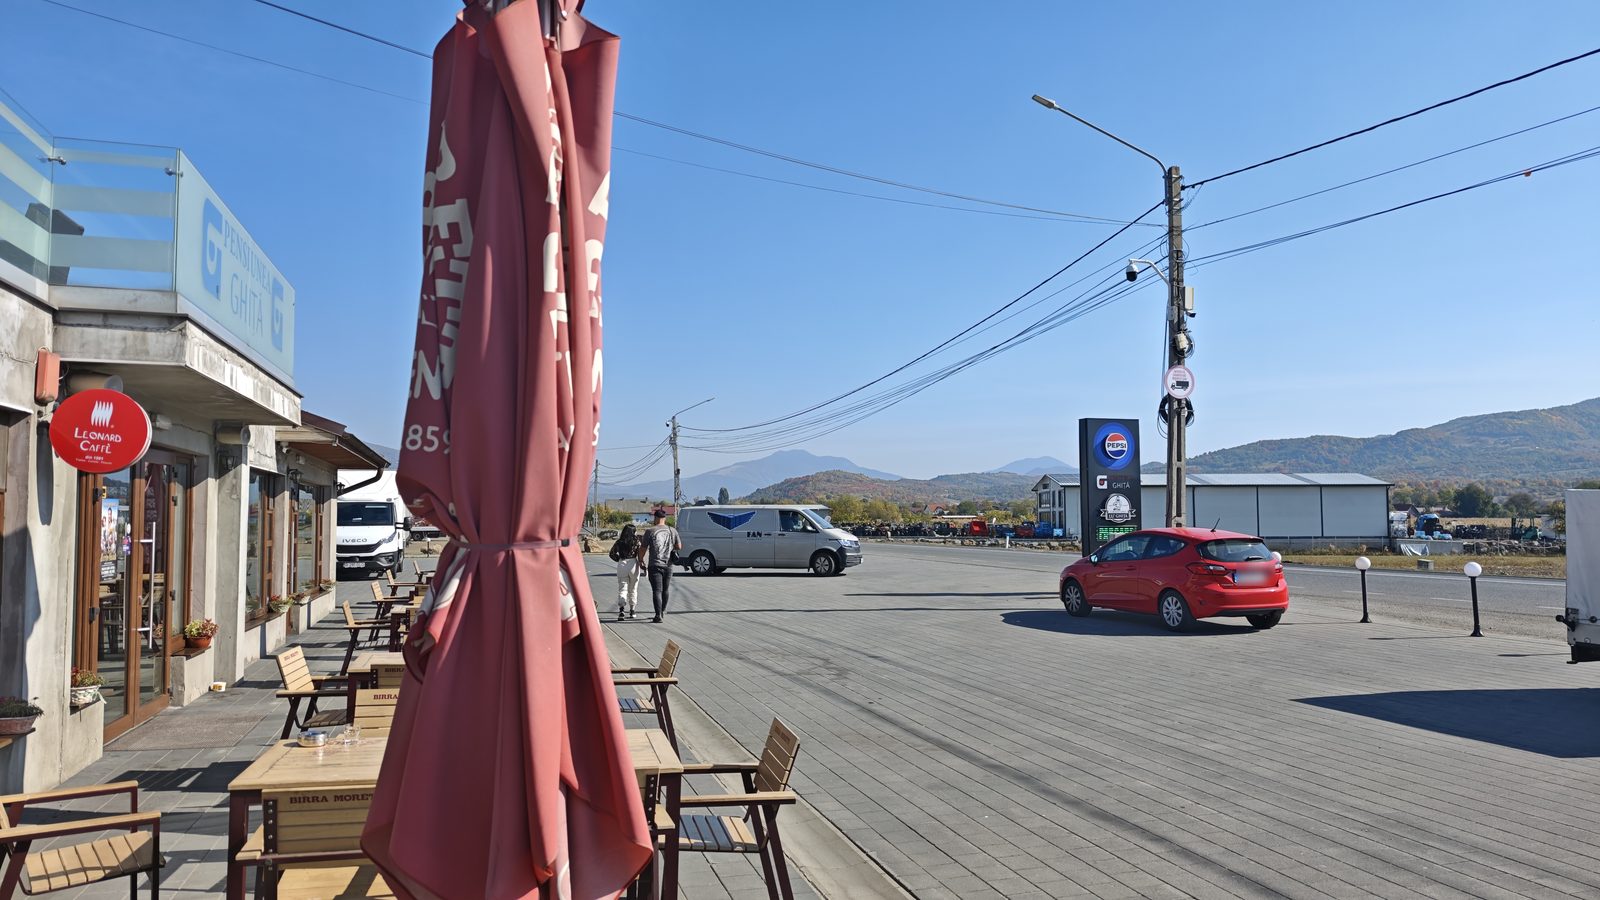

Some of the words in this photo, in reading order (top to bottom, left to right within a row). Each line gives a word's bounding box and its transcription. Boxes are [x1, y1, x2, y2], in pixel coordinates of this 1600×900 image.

[224, 218, 272, 296] PENSIUNEA
[74, 427, 122, 443] LEONARD
[79, 440, 112, 454] CAFFÈ
[289, 795, 329, 804] BIRRA
